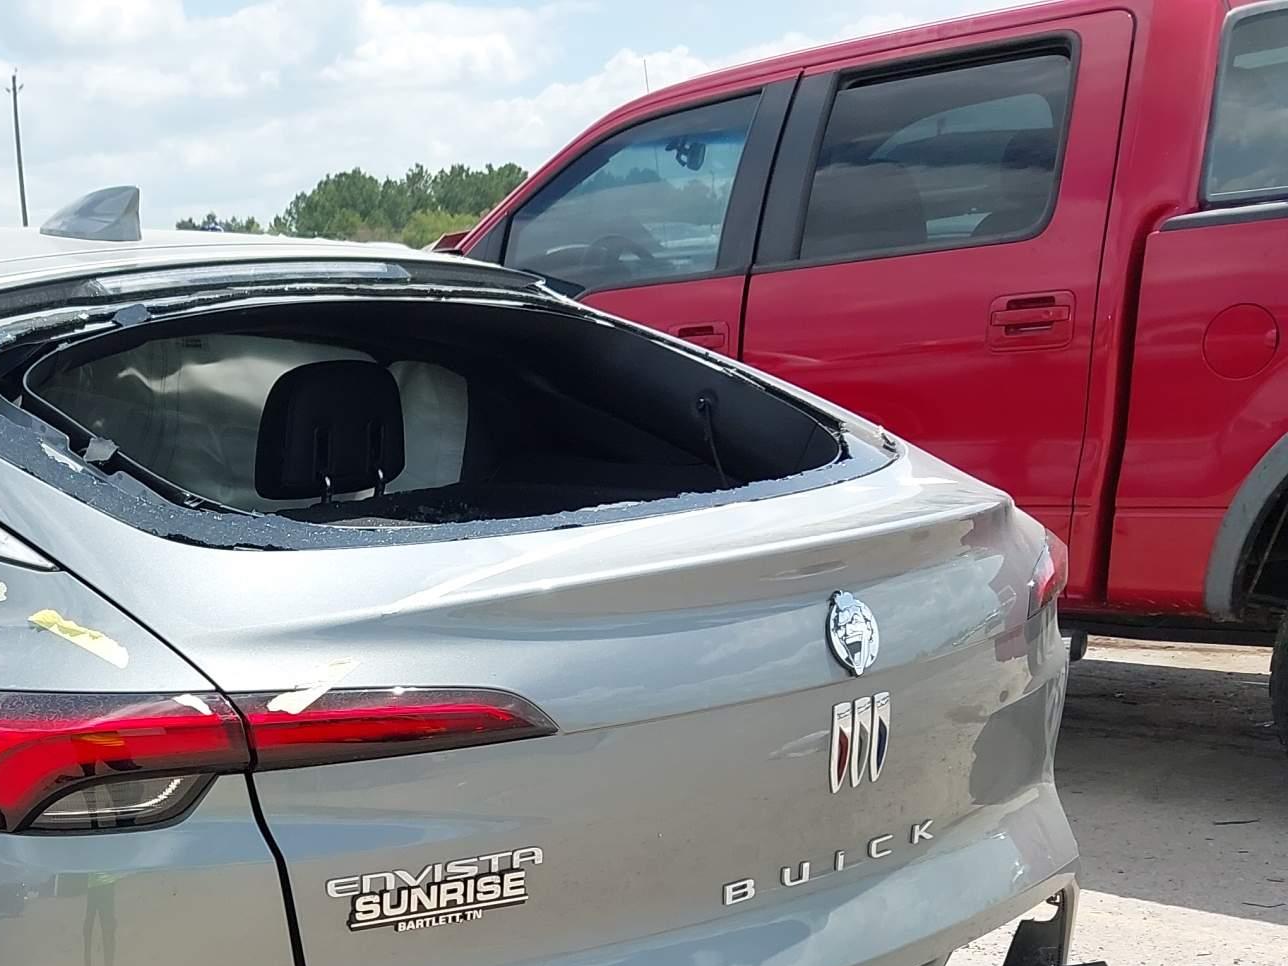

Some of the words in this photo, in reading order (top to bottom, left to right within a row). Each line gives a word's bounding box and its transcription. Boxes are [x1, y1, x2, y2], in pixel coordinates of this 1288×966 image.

[325, 846, 544, 898] ENVISTA
[722, 818, 934, 906] BUICK
[354, 870, 526, 922] SUNRISE
[397, 912, 464, 932] BARTLETT,
[465, 908, 483, 921] TN
